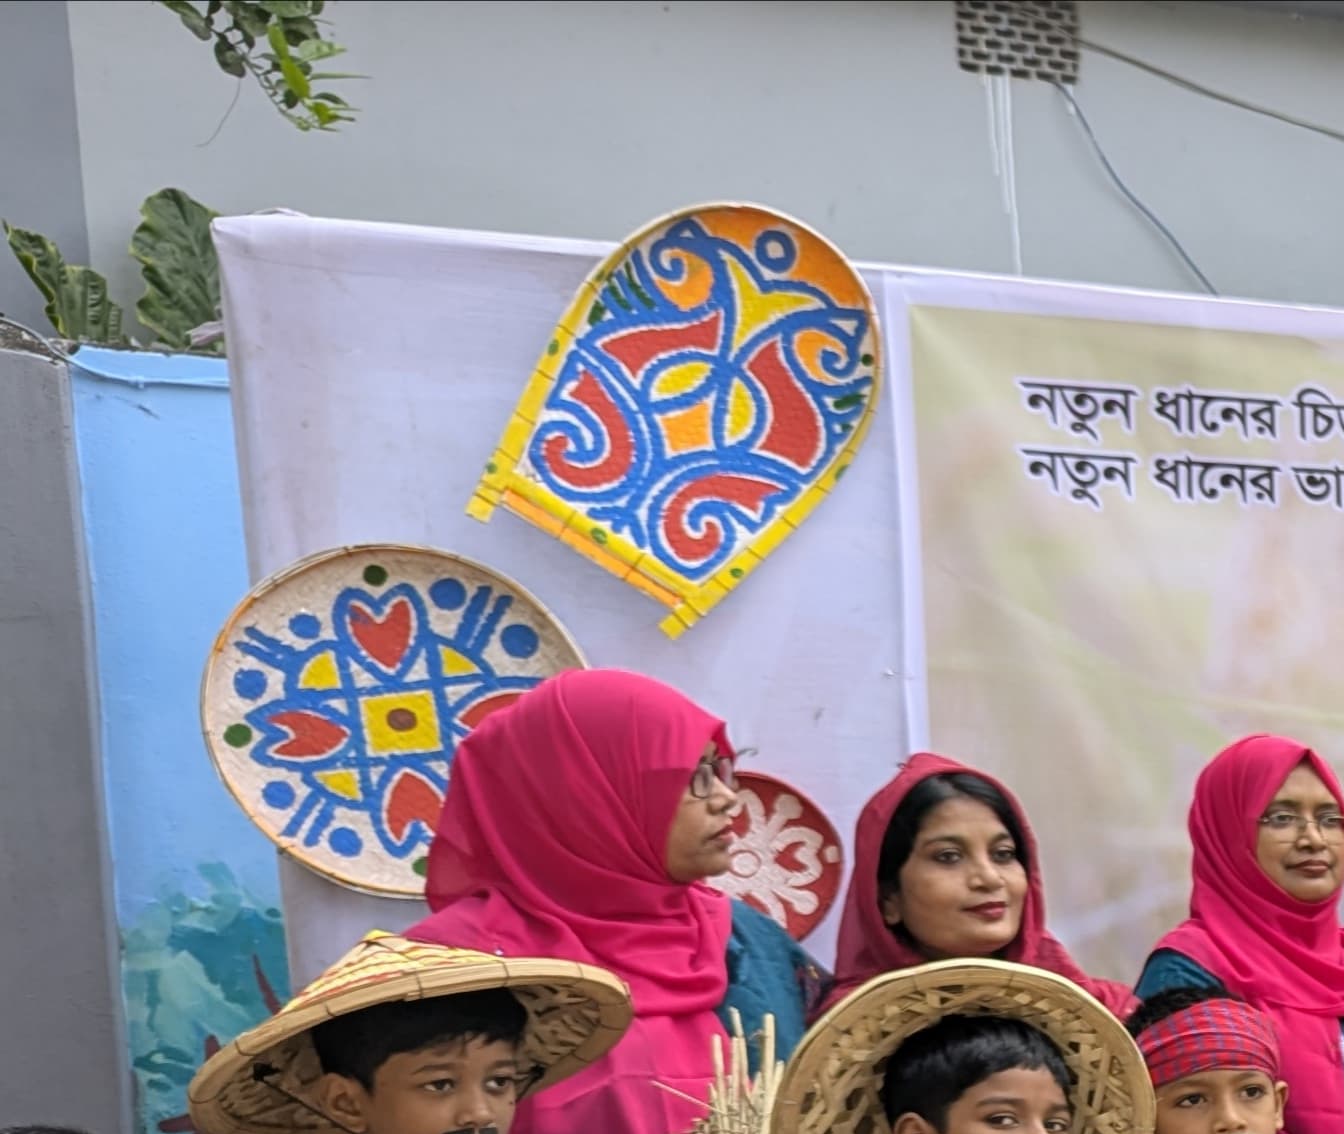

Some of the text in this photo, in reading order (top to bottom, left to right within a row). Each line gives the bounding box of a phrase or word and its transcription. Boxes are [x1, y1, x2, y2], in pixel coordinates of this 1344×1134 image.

[1019, 381, 1138, 440] নতুন
[1154, 388, 1283, 438] ধানের
[1019, 448, 1137, 507] নতুন
[1154, 455, 1282, 503] ধানের
